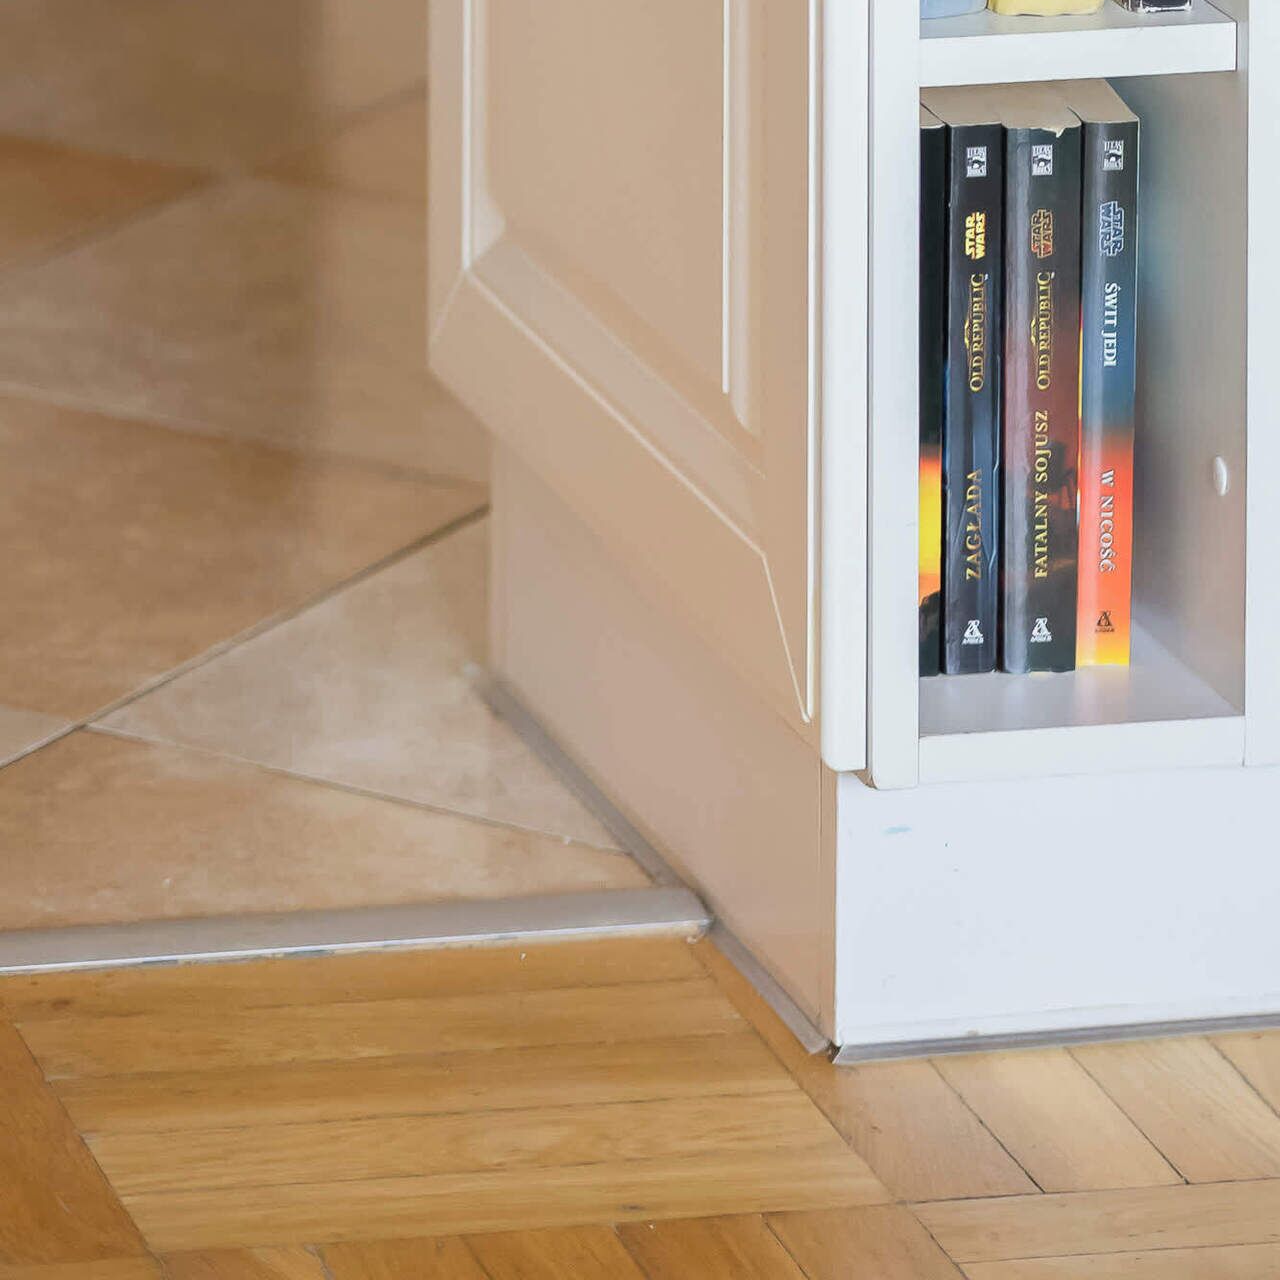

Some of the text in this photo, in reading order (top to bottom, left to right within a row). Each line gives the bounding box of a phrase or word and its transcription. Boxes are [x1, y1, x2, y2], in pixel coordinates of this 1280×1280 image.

[965, 213, 976, 259] STAR
[975, 211, 986, 260] WARS
[1031, 210, 1042, 258] STAR
[1042, 209, 1053, 259] WARS
[1100, 201, 1113, 255] WARS
[1112, 208, 1124, 255] STAR
[969, 274, 984, 392] OLD REPUBLIC
[1036, 271, 1051, 390] OLD REPUBLIC
[1103, 283, 1121, 367] ŚWIT JEDI
[966, 469, 983, 581] ZAGŁADA
[1034, 410, 1051, 579] FATALNY SOJUSZ
[1099, 469, 1117, 573] W NICOŚĆ
